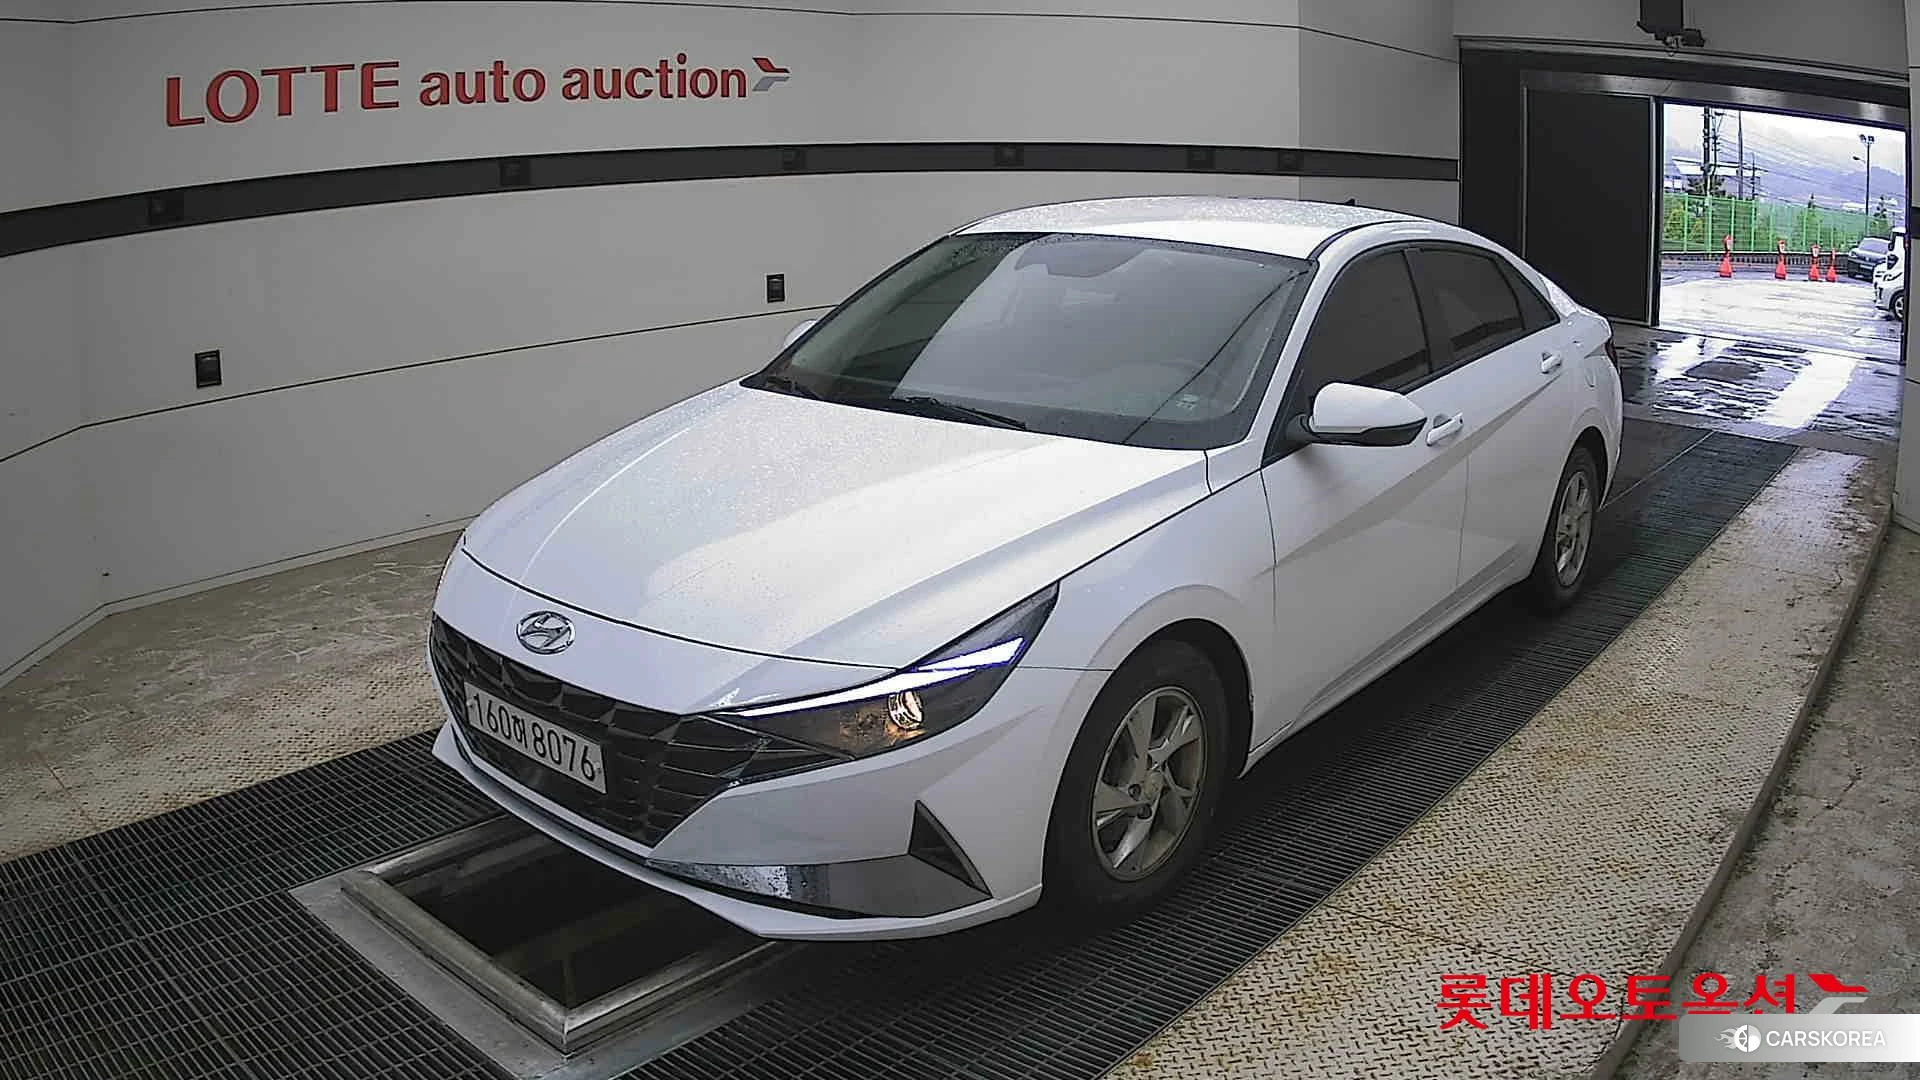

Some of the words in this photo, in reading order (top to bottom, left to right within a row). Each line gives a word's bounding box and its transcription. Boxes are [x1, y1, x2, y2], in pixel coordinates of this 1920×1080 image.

[165, 60, 400, 127] LOTTE
[418, 59, 547, 106] auto
[561, 52, 748, 100] auction
